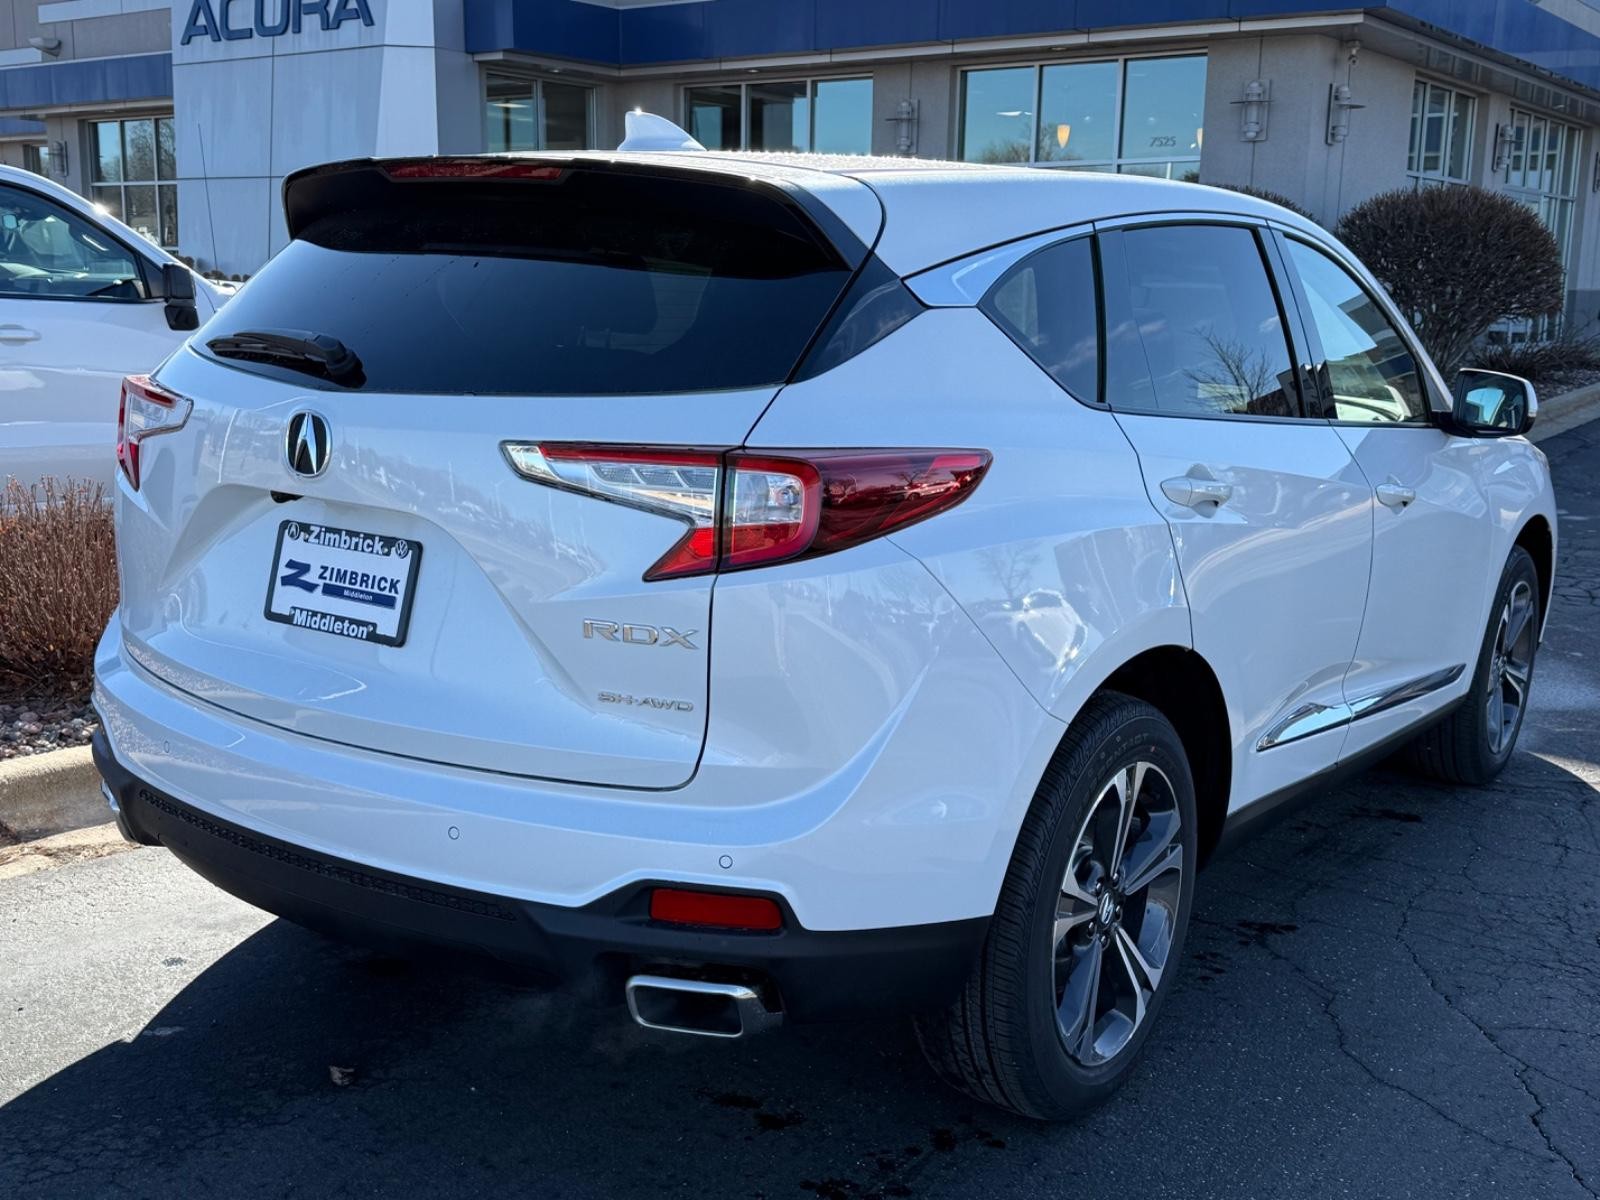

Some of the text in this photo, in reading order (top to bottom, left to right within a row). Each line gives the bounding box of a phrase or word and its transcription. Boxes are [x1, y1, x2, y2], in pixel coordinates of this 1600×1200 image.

[180, 0, 375, 46] ACURA
[1150, 136, 1176, 147] 7525
[307, 526, 384, 555] Zimbrick
[318, 565, 401, 595] ZIMBRICK
[292, 608, 368, 639] Middleton
[583, 618, 699, 649] RDX
[598, 691, 694, 712] SH-AWD
